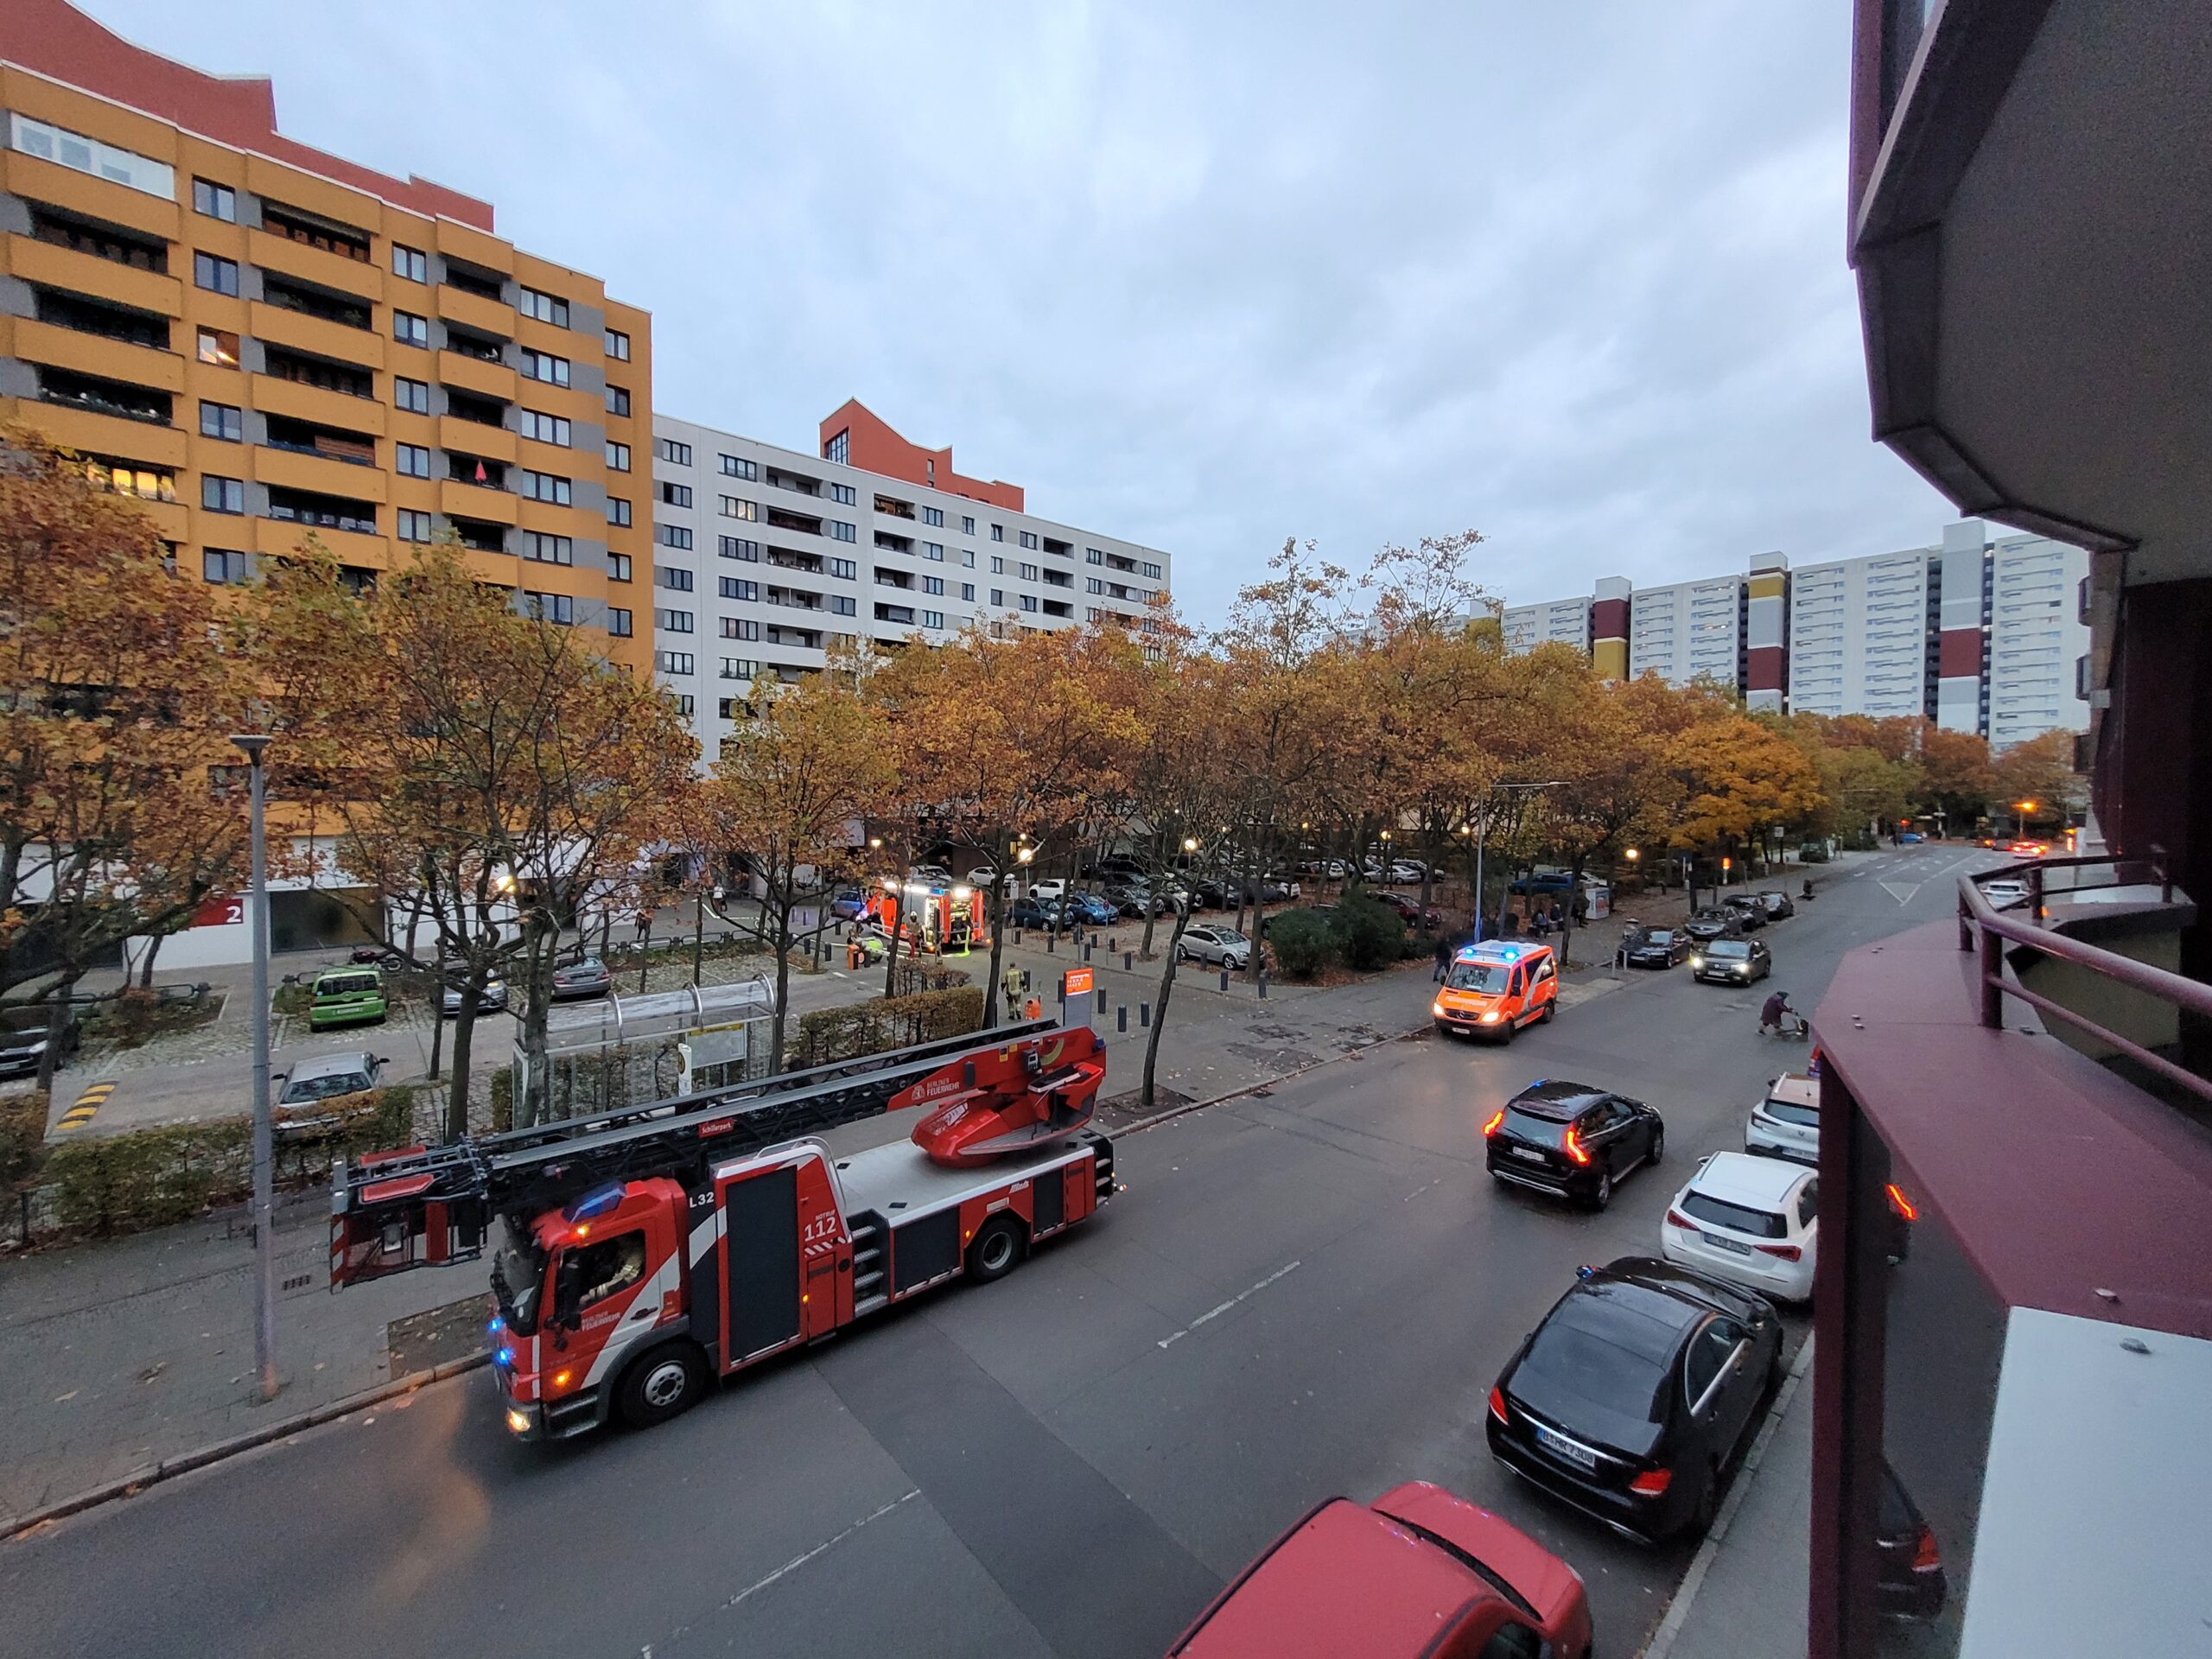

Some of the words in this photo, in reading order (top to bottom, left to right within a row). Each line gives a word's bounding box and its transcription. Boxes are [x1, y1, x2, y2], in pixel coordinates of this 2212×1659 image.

[226, 906, 241, 923] 2
[926, 1077, 950, 1089] BERLINER
[926, 1082, 960, 1096] FEUERWEHR
[702, 1122, 731, 1134] Schillerpark
[690, 1192, 715, 1208] L32
[815, 1210, 836, 1221] NOTRUF
[804, 1217, 836, 1242] 112
